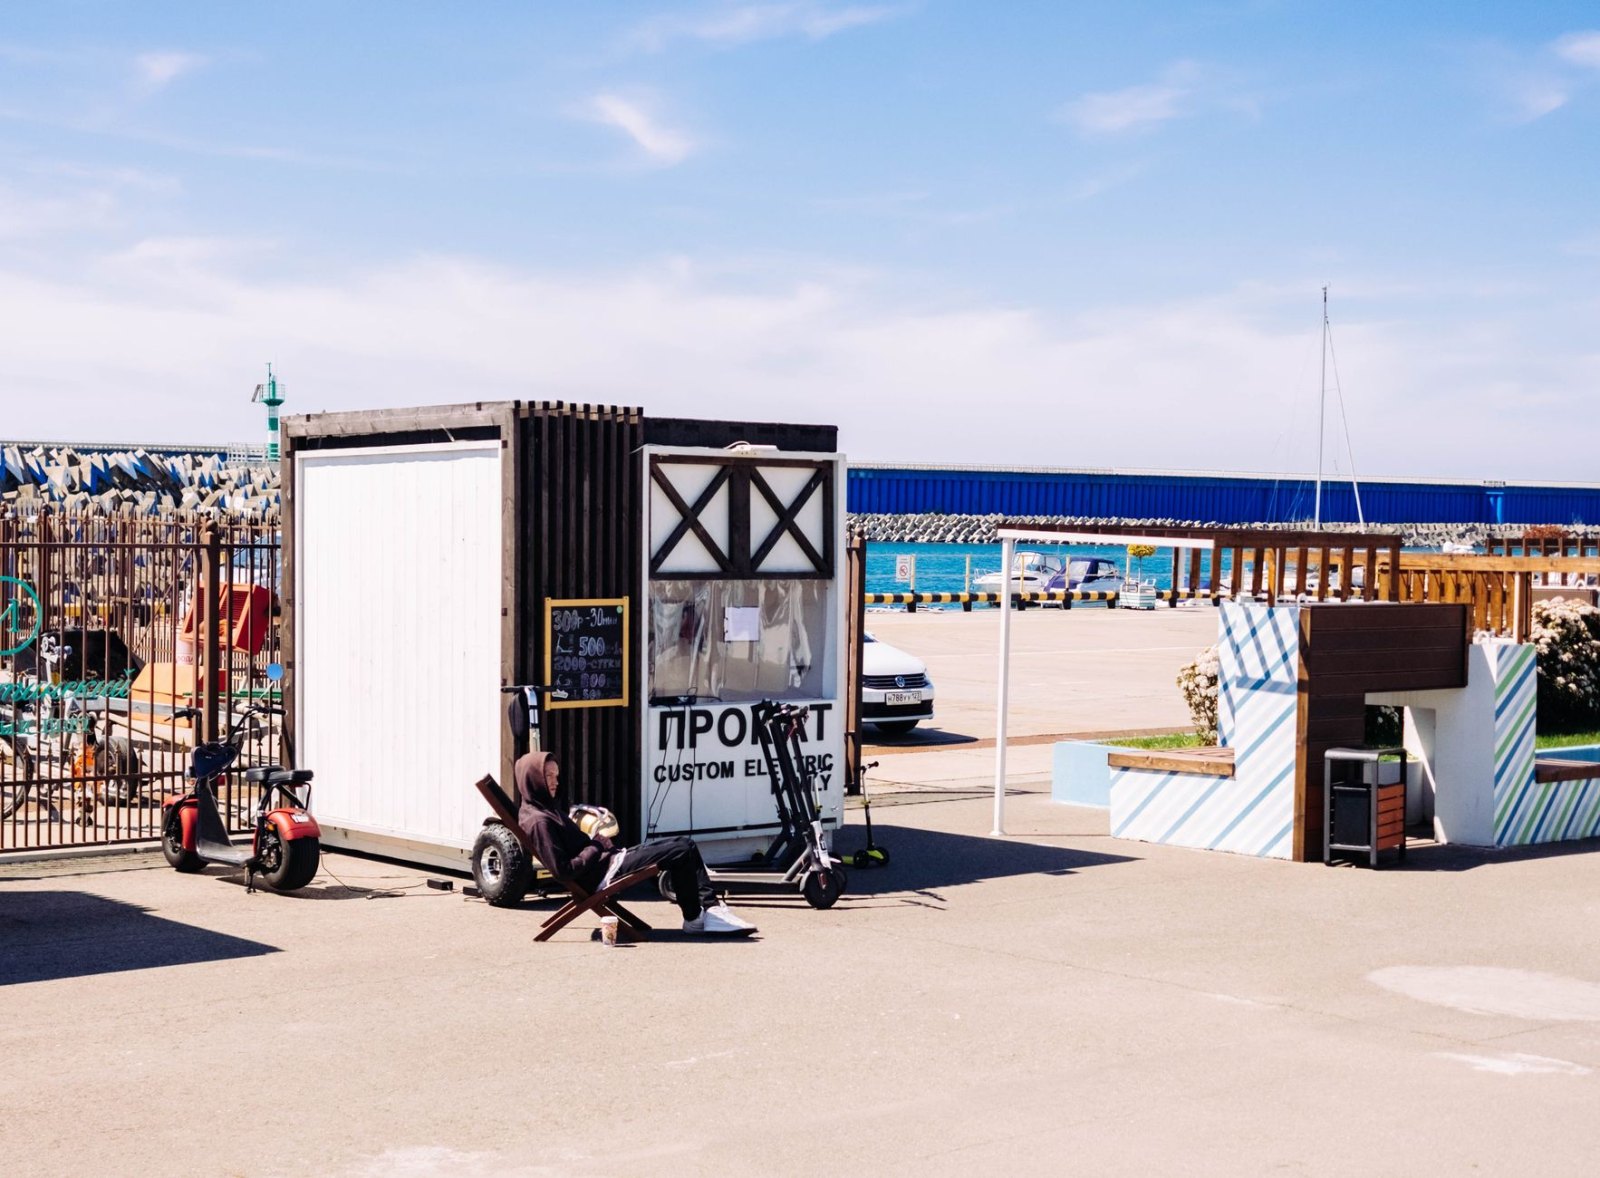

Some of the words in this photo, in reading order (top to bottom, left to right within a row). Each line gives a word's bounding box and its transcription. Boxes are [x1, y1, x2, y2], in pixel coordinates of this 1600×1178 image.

[578, 636, 605, 657] 500
[653, 761, 734, 783] CUSTOM
[744, 753, 833, 777] ELERIC
